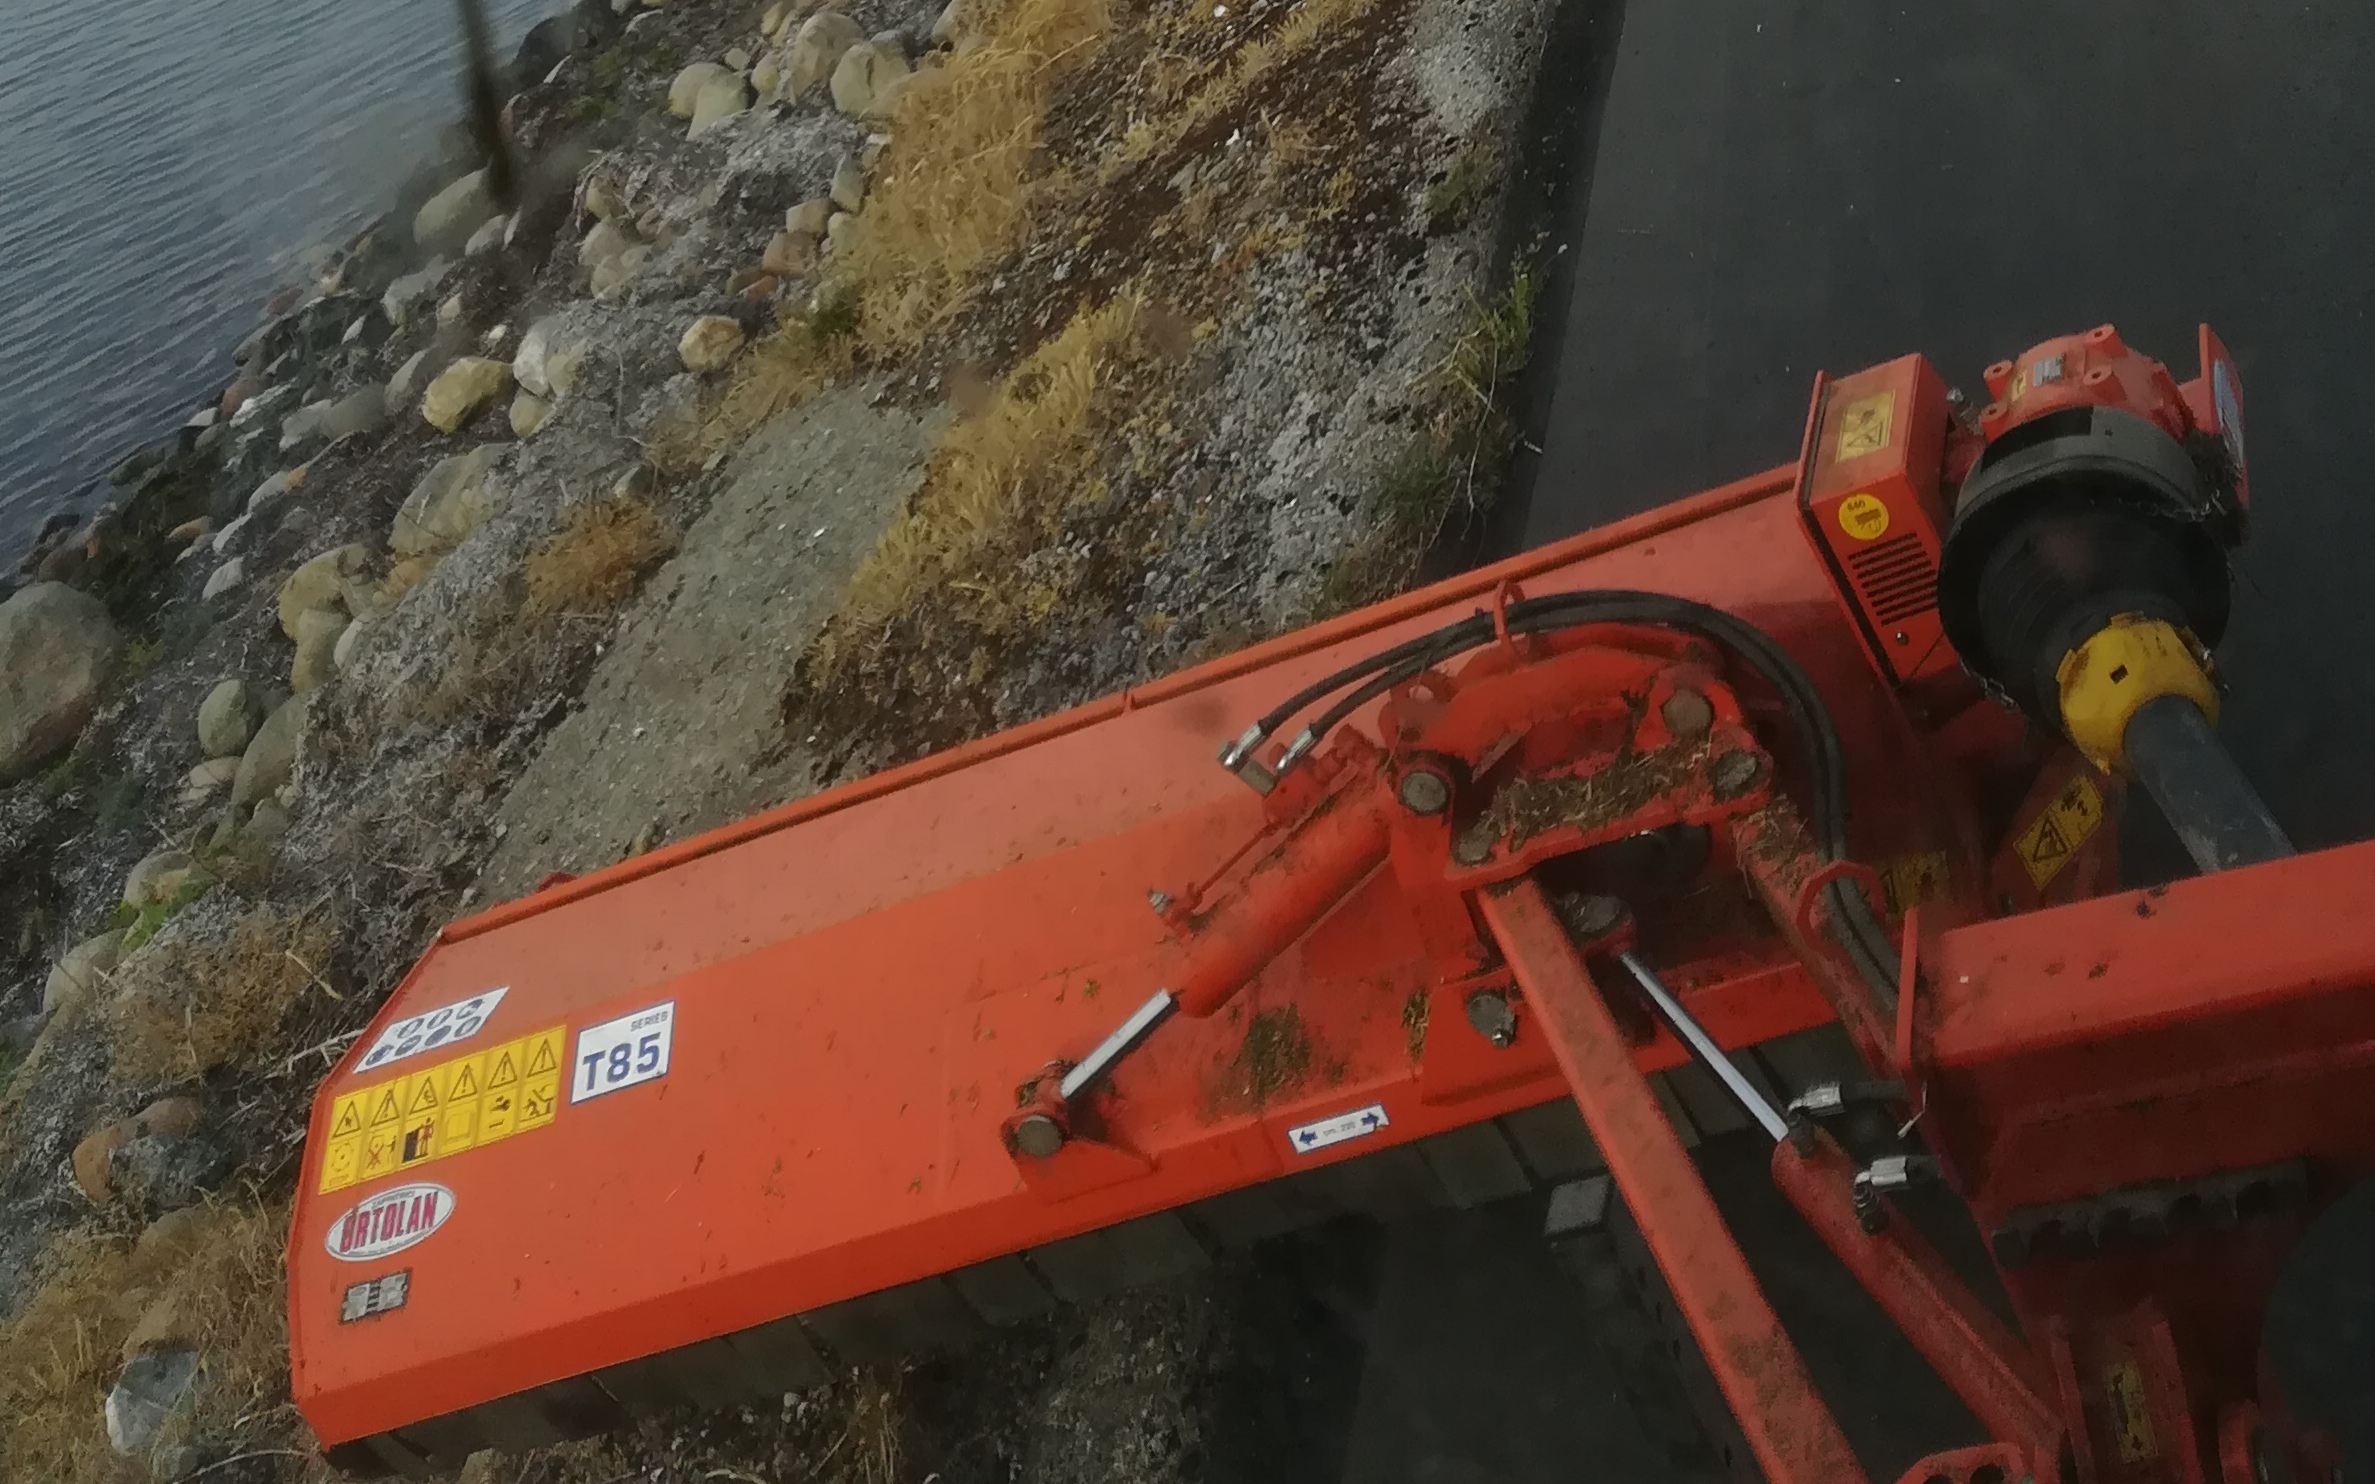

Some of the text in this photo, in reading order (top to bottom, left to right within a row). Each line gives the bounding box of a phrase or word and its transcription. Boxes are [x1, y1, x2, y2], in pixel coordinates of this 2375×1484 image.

[630, 1010, 669, 1032] SERIES
[582, 1032, 662, 1092] T85
[339, 1190, 439, 1253] ORTOLAN
